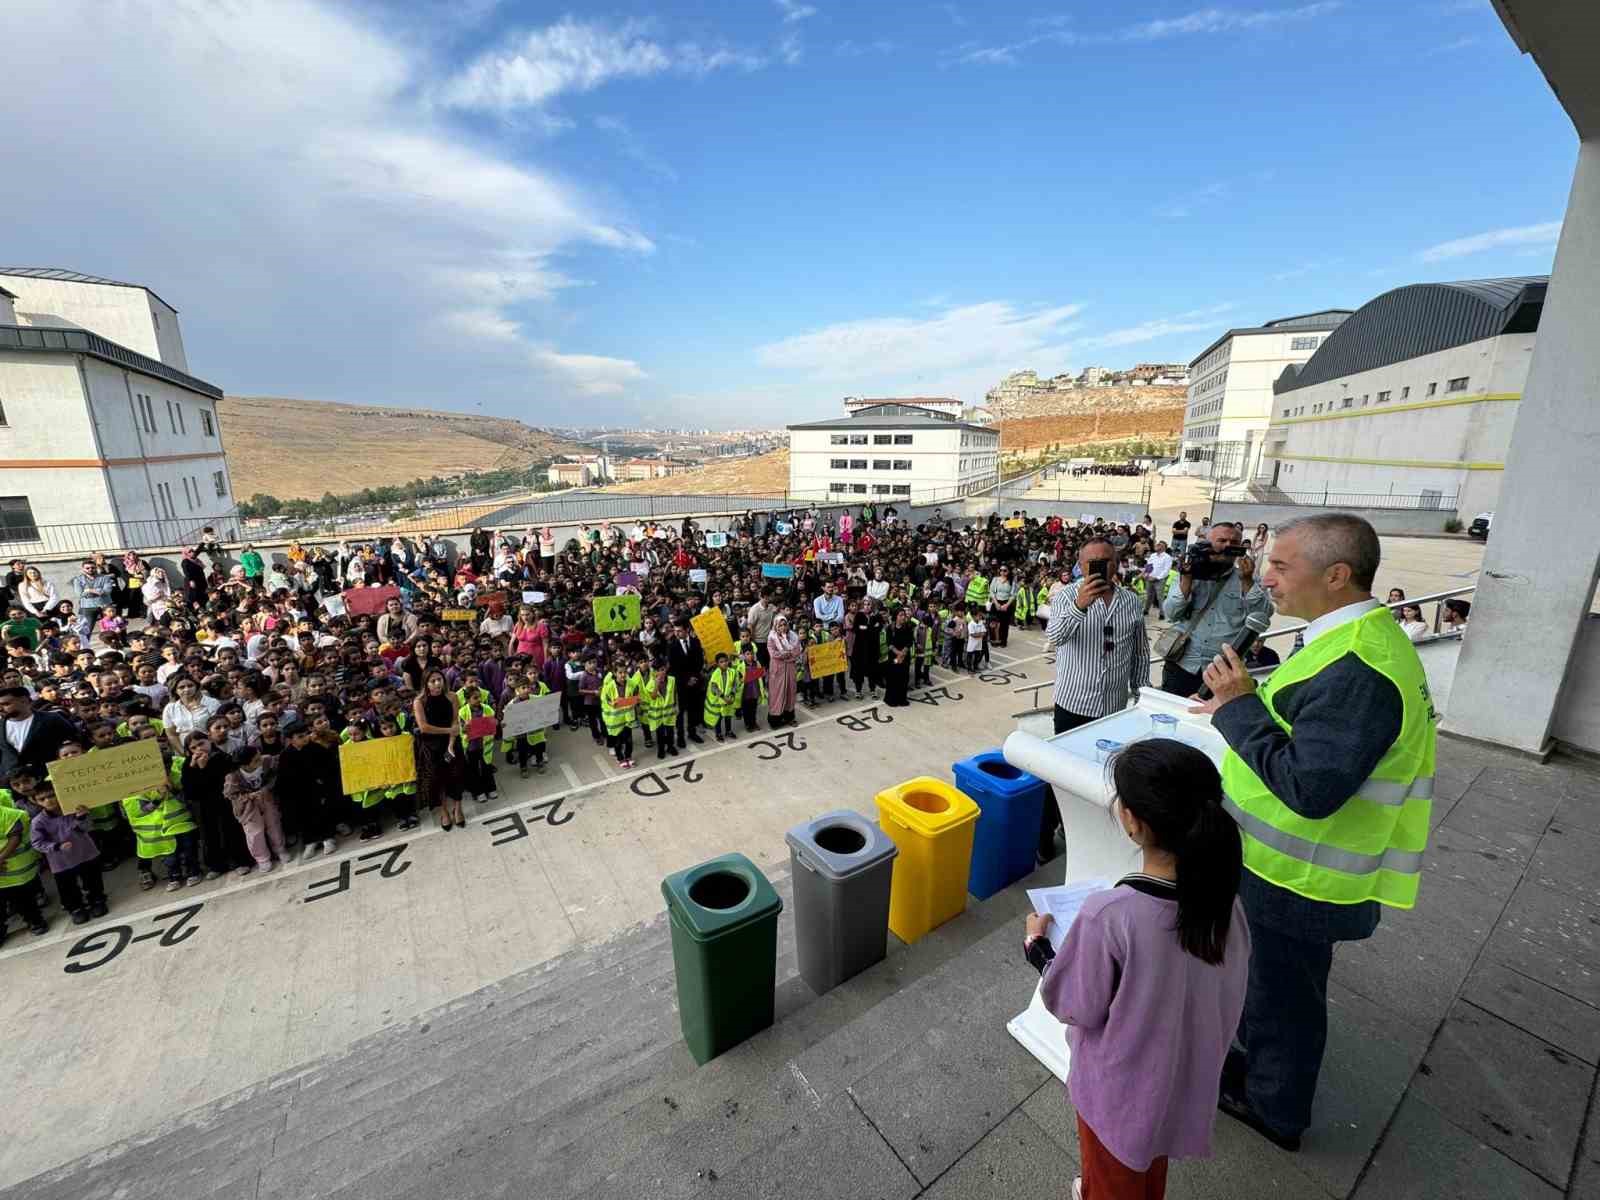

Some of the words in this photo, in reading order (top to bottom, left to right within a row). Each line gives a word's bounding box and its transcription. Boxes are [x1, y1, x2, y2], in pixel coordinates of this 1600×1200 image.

[907, 686, 964, 706] 2-A
[836, 707, 894, 731] 2-B
[747, 731, 808, 760] 2-C
[630, 760, 704, 797] 2-D
[482, 796, 576, 847] 2-E
[304, 842, 412, 903] 2-F
[63, 902, 205, 974] 2-G
